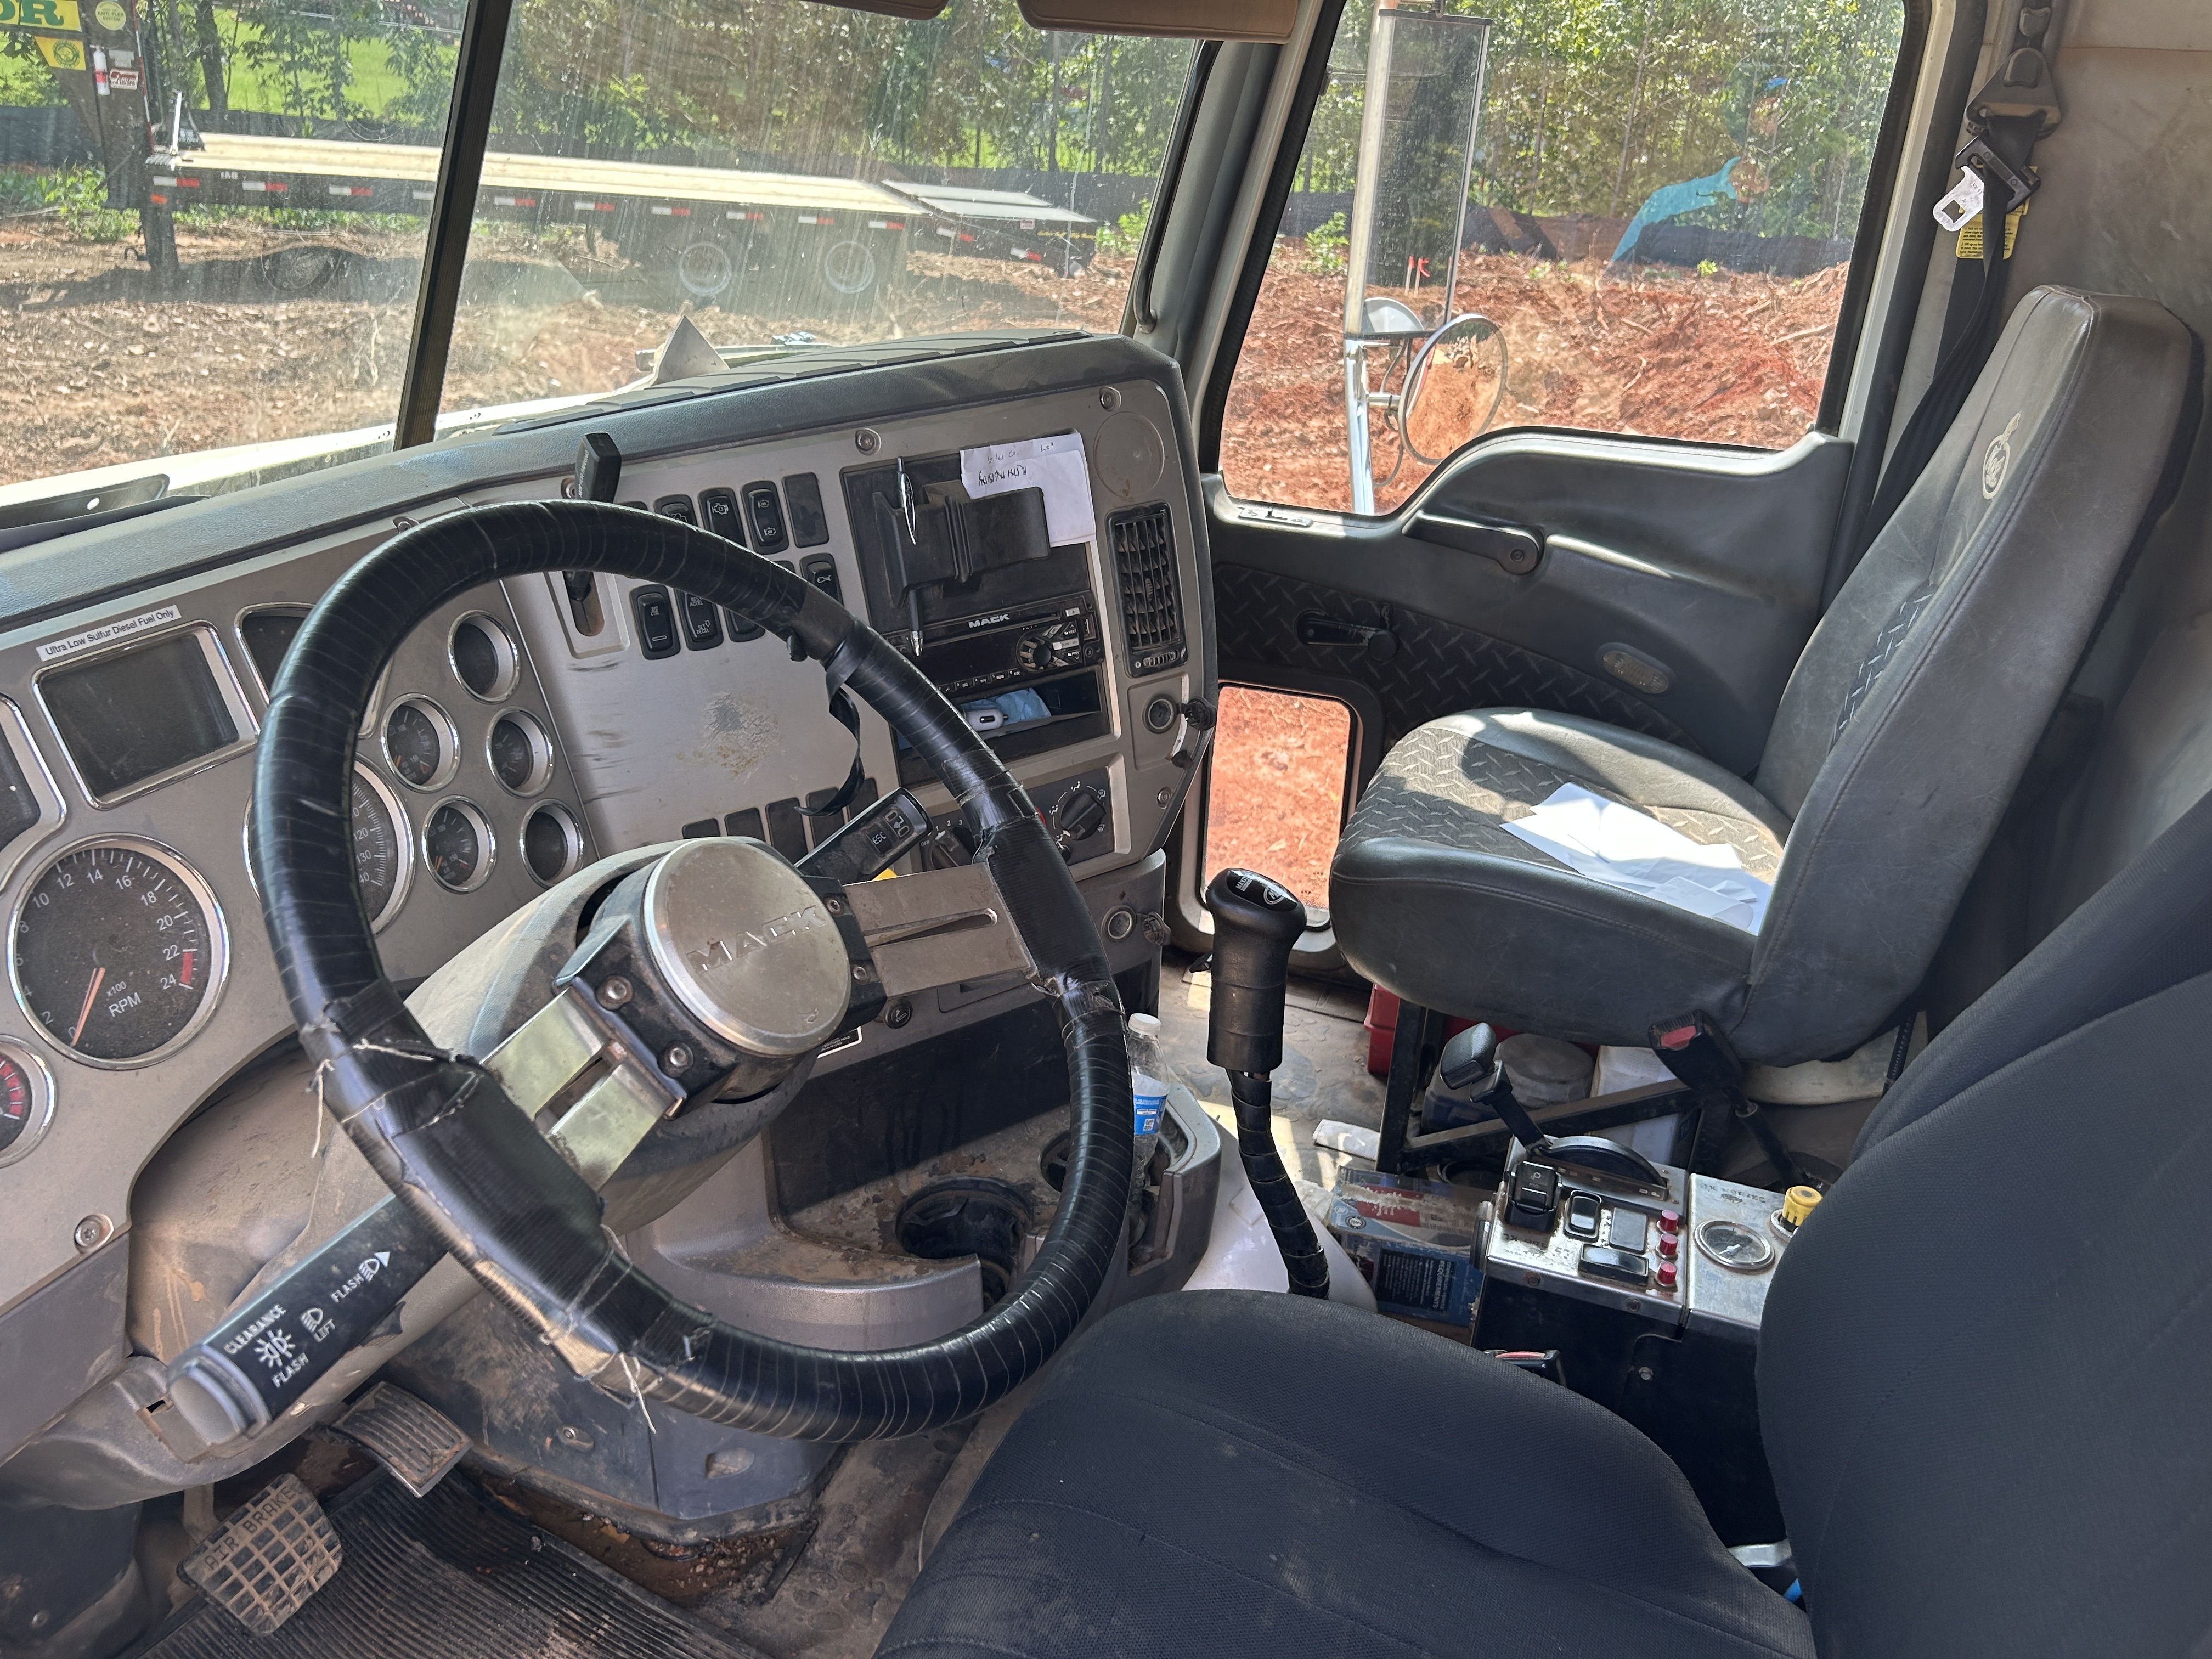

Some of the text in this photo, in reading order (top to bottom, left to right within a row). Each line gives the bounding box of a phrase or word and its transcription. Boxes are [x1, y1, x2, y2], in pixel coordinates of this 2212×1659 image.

[968, 613, 1010, 628] MACK
[45, 610, 174, 655] Ultra Low Sulfur Diesel Fuel Only
[353, 827, 369, 842] 120
[872, 831, 887, 845] ESC
[357, 850, 371, 864] 130
[57, 873, 75, 889] 12
[87, 869, 103, 884] 14
[115, 875, 132, 889] 16
[359, 872, 370, 883] 40
[32, 893, 50, 908] 10
[140, 891, 157, 906] 18
[19, 921, 29, 933] 8
[156, 915, 173, 932] 20
[686, 905, 828, 975] MACK
[163, 944, 180, 961] 22
[106, 981, 127, 997] x100
[160, 973, 177, 990] 24
[109, 992, 142, 1017] RPM
[41, 1011, 54, 1025] 2
[67, 1026, 76, 1039] 0
[330, 1273, 365, 1303] FLASH
[224, 1304, 286, 1354] CLEARANCE
[313, 1318, 336, 1342] LIFT
[272, 1352, 309, 1389] FLASH
[204, 1486, 296, 1570] AIR BRAKE
